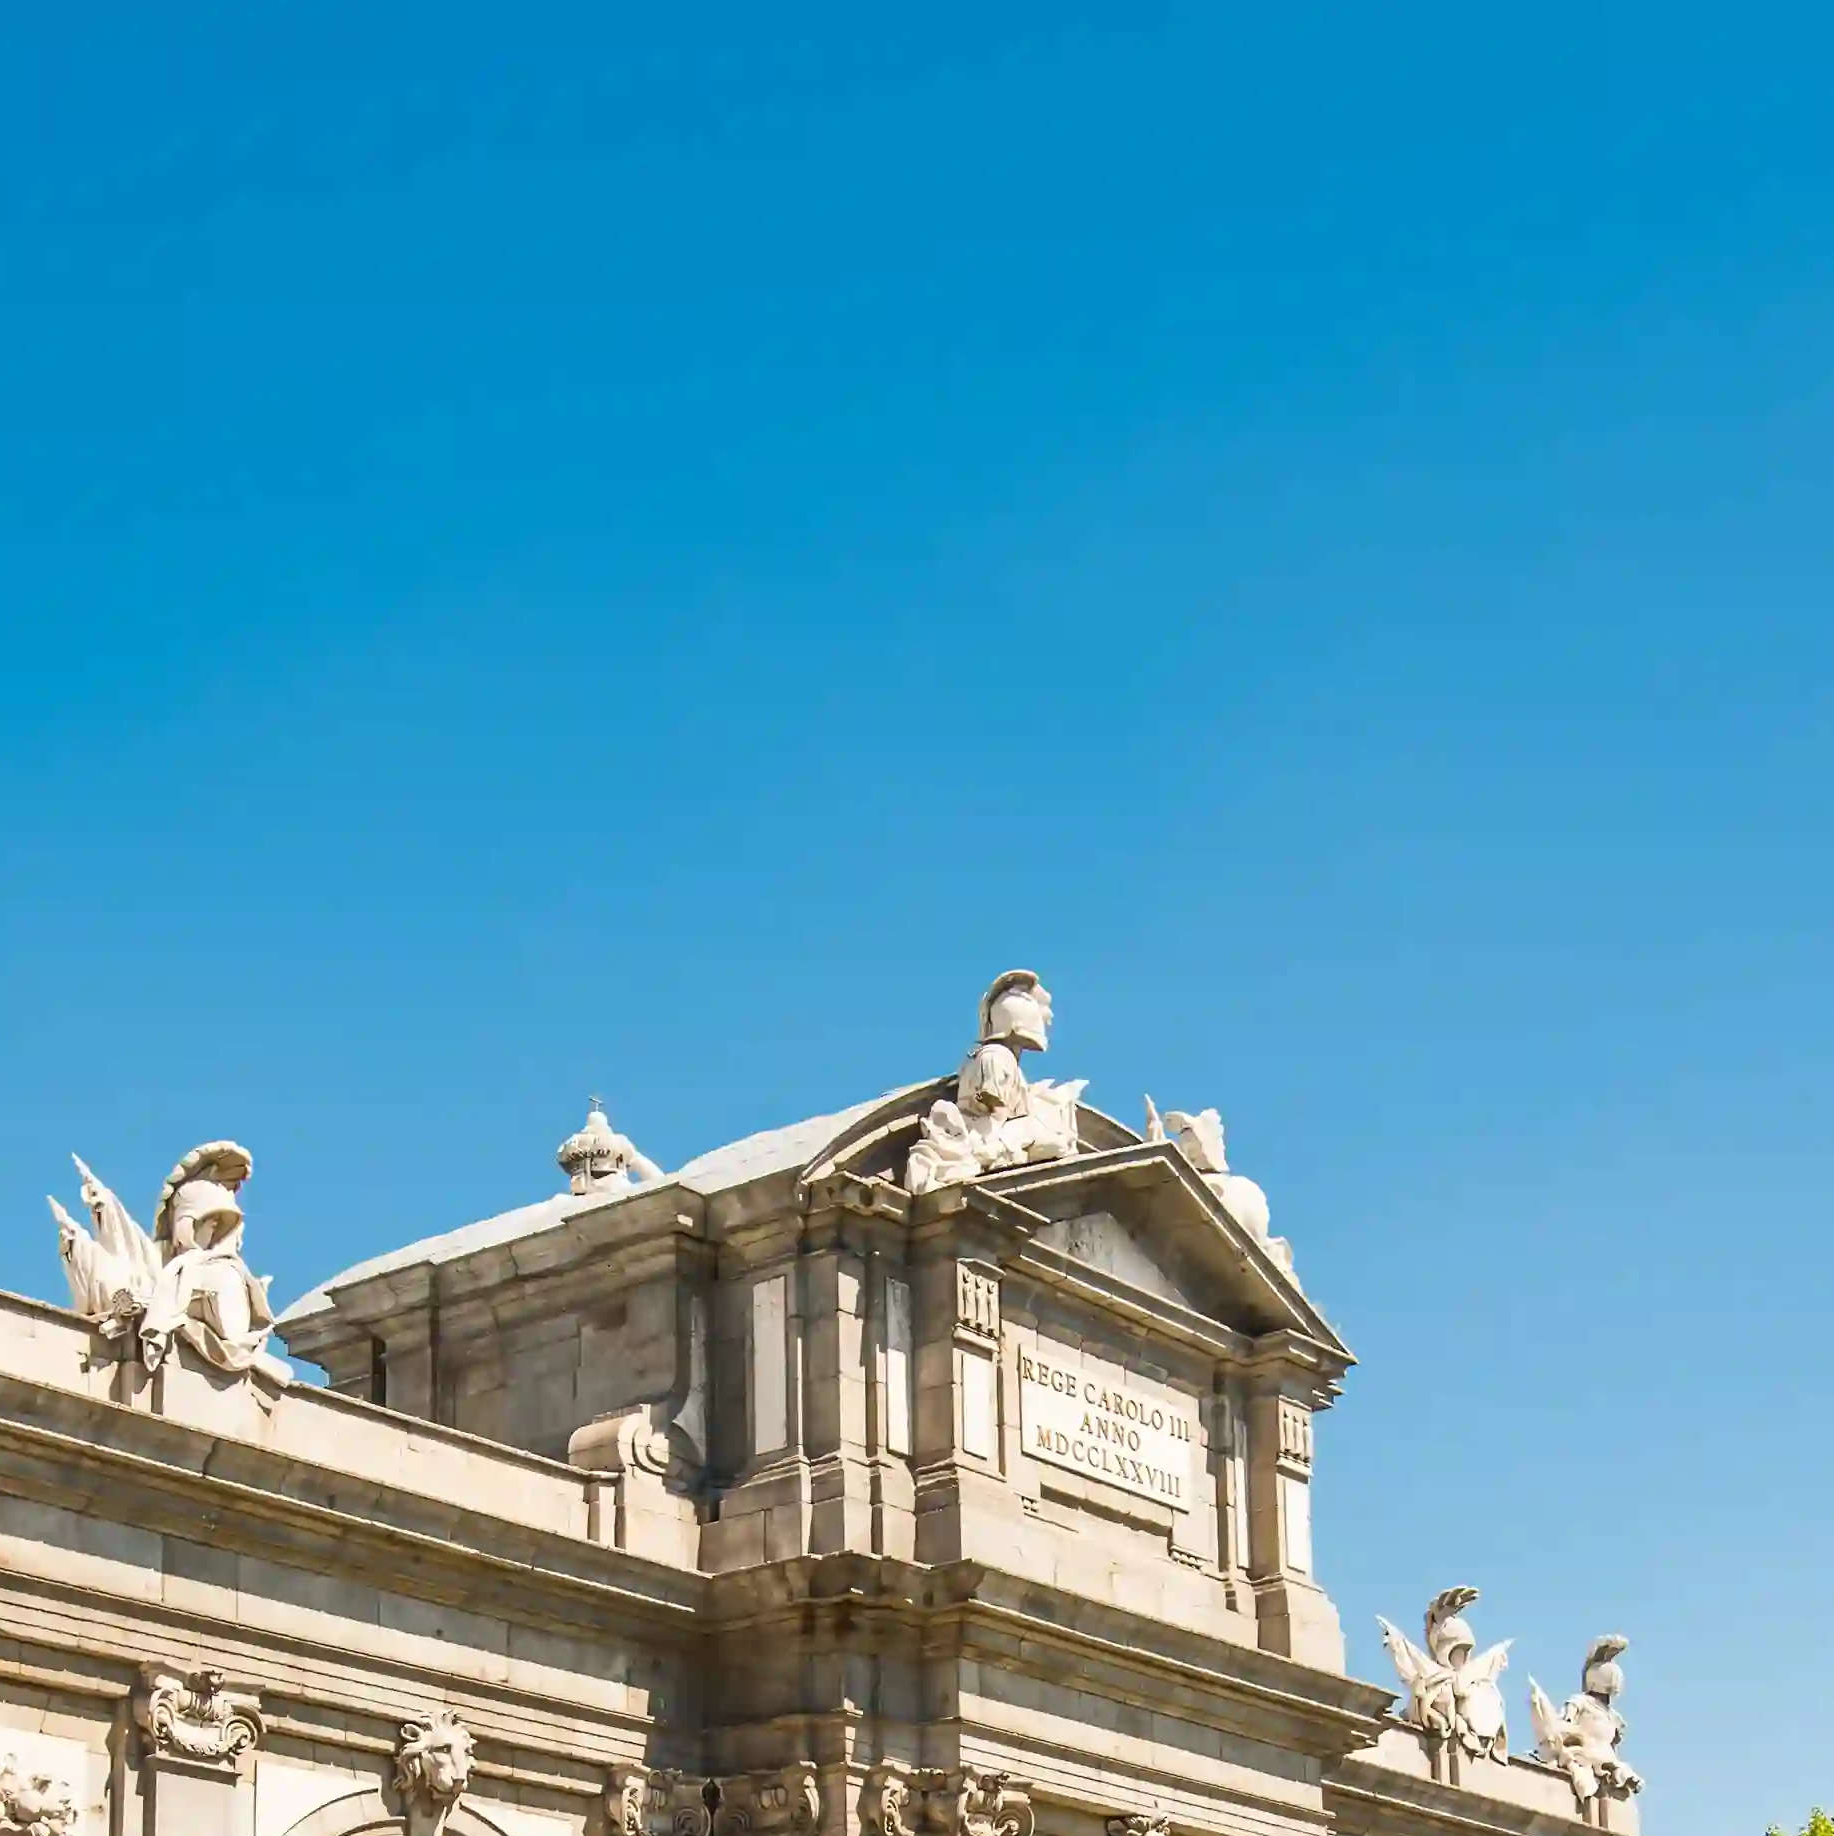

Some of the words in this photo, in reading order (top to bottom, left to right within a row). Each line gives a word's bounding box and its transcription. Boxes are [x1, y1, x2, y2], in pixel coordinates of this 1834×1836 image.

[1023, 1356, 1076, 1397] REGE
[1084, 1383, 1164, 1430] CAROLO
[1170, 1415, 1191, 1442] III
[1080, 1411, 1140, 1452] ANNO
[1036, 1424, 1180, 1498] MDCCLXXVIII
